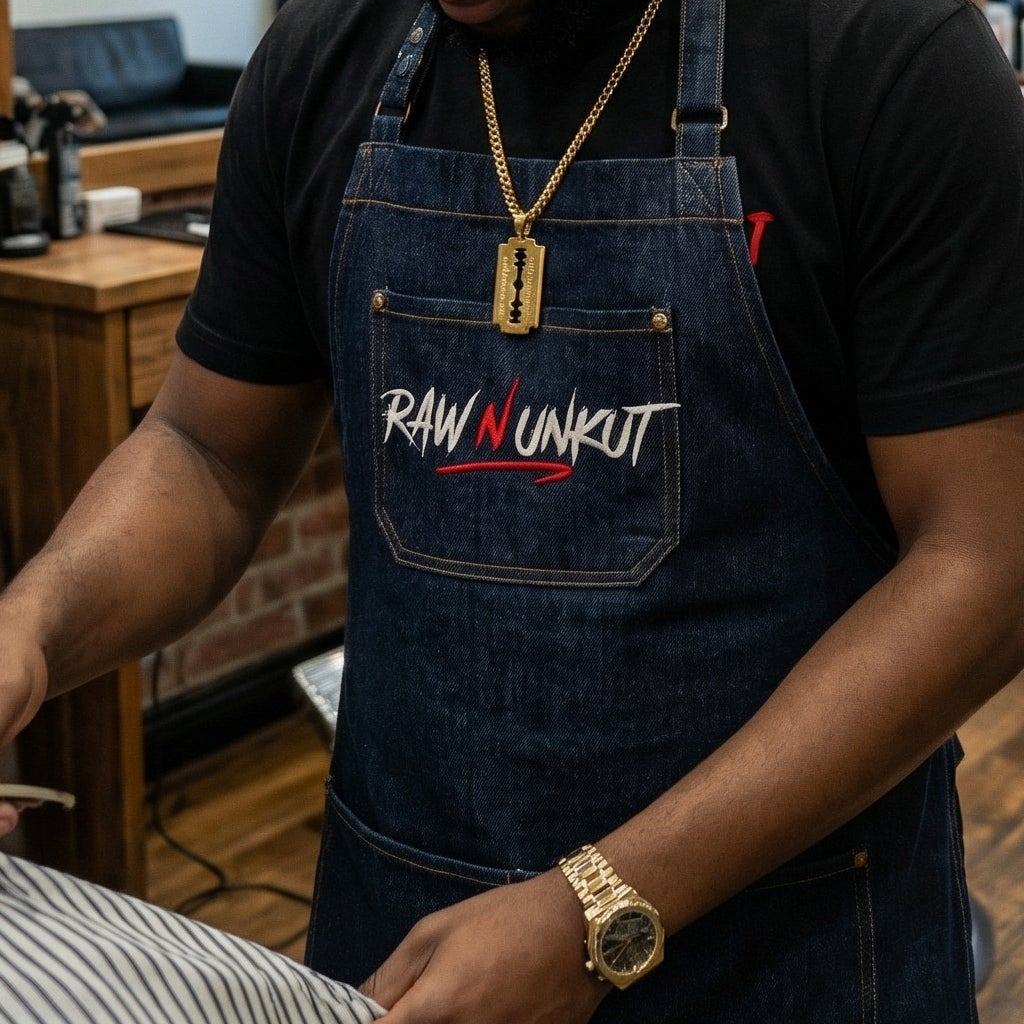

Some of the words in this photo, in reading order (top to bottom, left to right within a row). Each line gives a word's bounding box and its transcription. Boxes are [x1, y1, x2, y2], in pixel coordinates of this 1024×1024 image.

[380, 387, 481, 458] RAW
[475, 377, 520, 451] N
[514, 387, 681, 467] UNKUT
